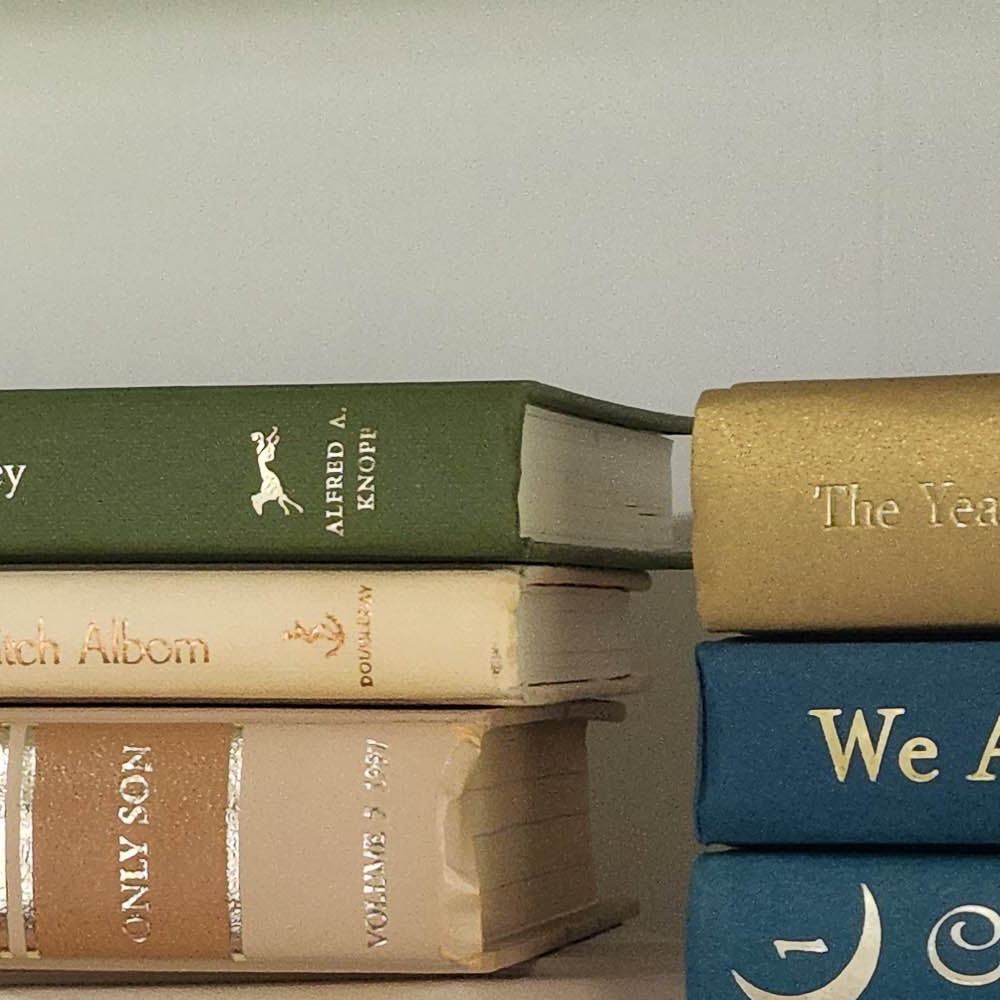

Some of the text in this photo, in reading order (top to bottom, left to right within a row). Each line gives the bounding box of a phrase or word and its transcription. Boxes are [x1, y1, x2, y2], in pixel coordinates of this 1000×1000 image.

[324, 441, 346, 537] ALFRED
[812, 481, 900, 532] The
[77, 615, 212, 666] Albom
[807, 707, 940, 783] We
[117, 744, 153, 944] ONLY SON
